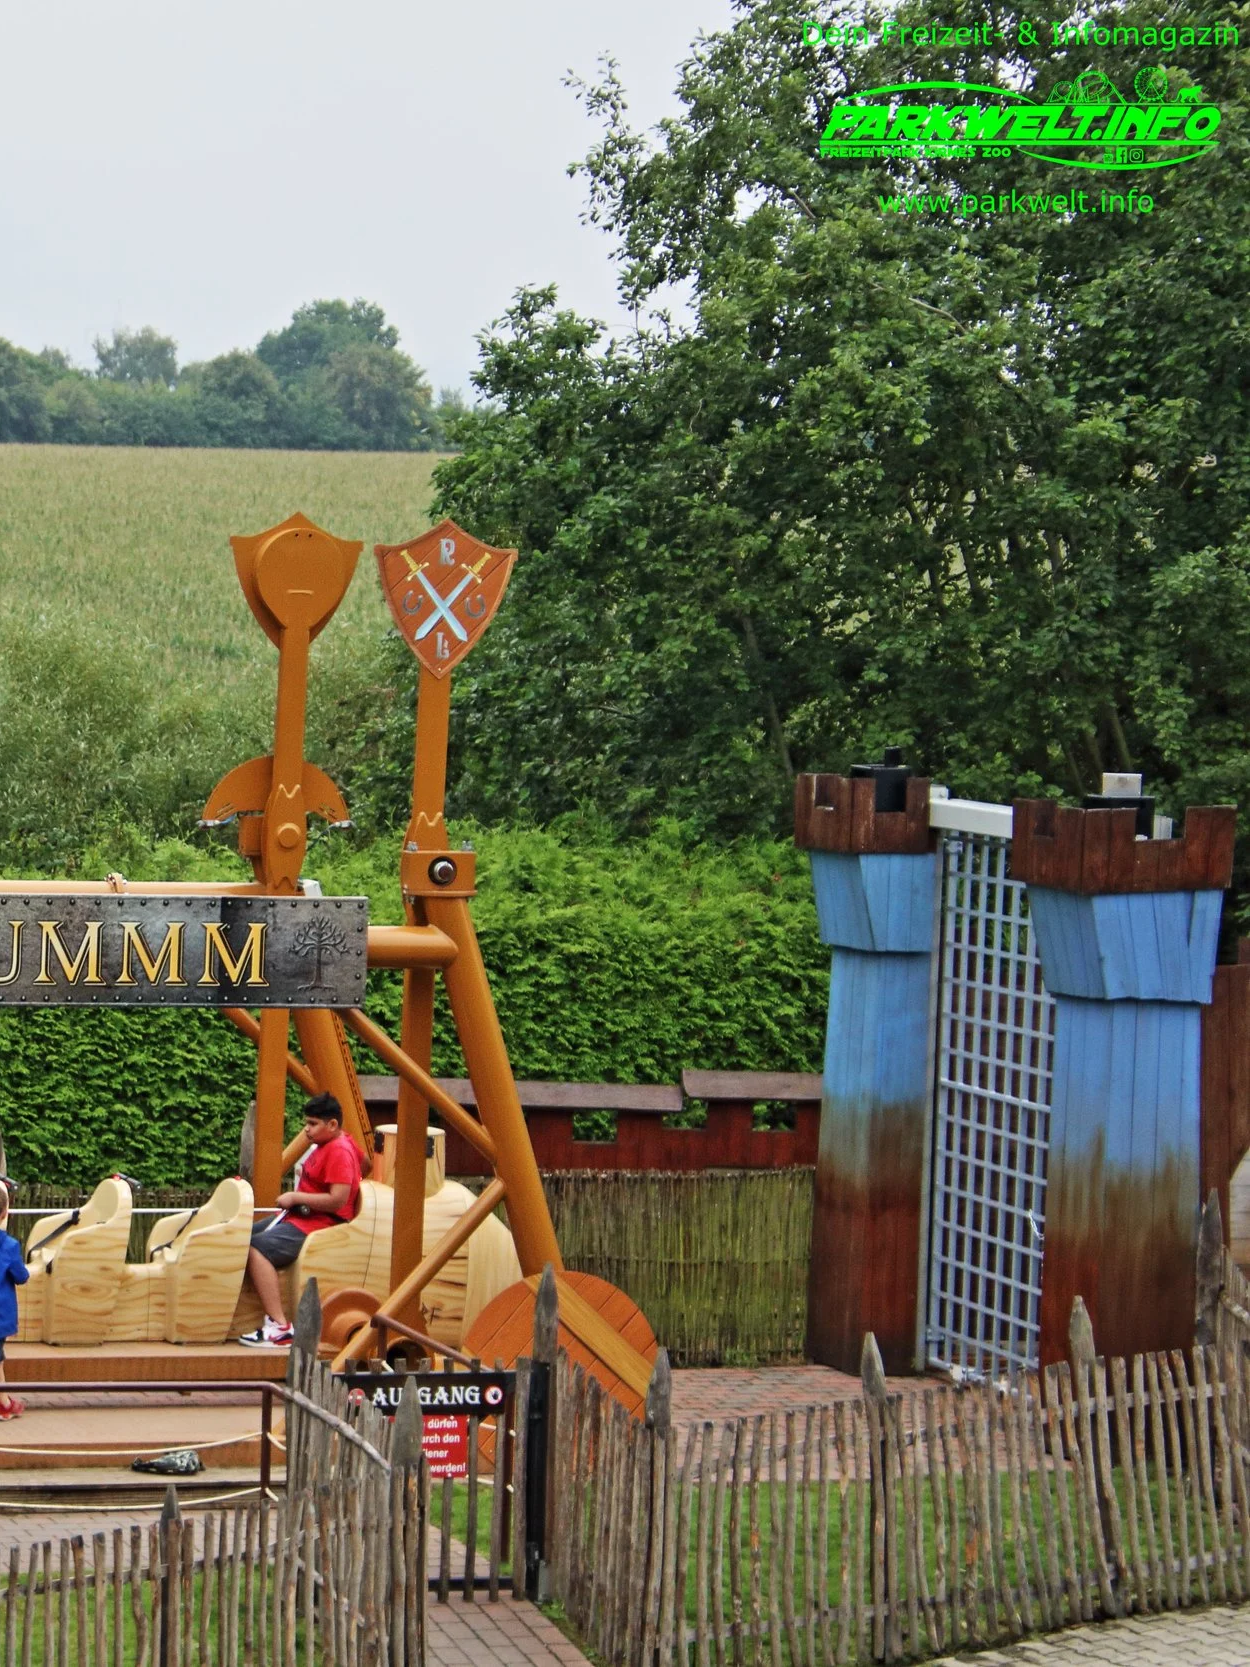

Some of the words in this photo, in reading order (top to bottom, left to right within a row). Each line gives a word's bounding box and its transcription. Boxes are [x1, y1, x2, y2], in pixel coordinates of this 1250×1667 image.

[439, 538, 456, 566] R
[372, 1385, 481, 1407] AUGANG
[427, 1418, 458, 1429] dürfen
[442, 1433, 461, 1444] den
[430, 1462, 466, 1472] werden!
